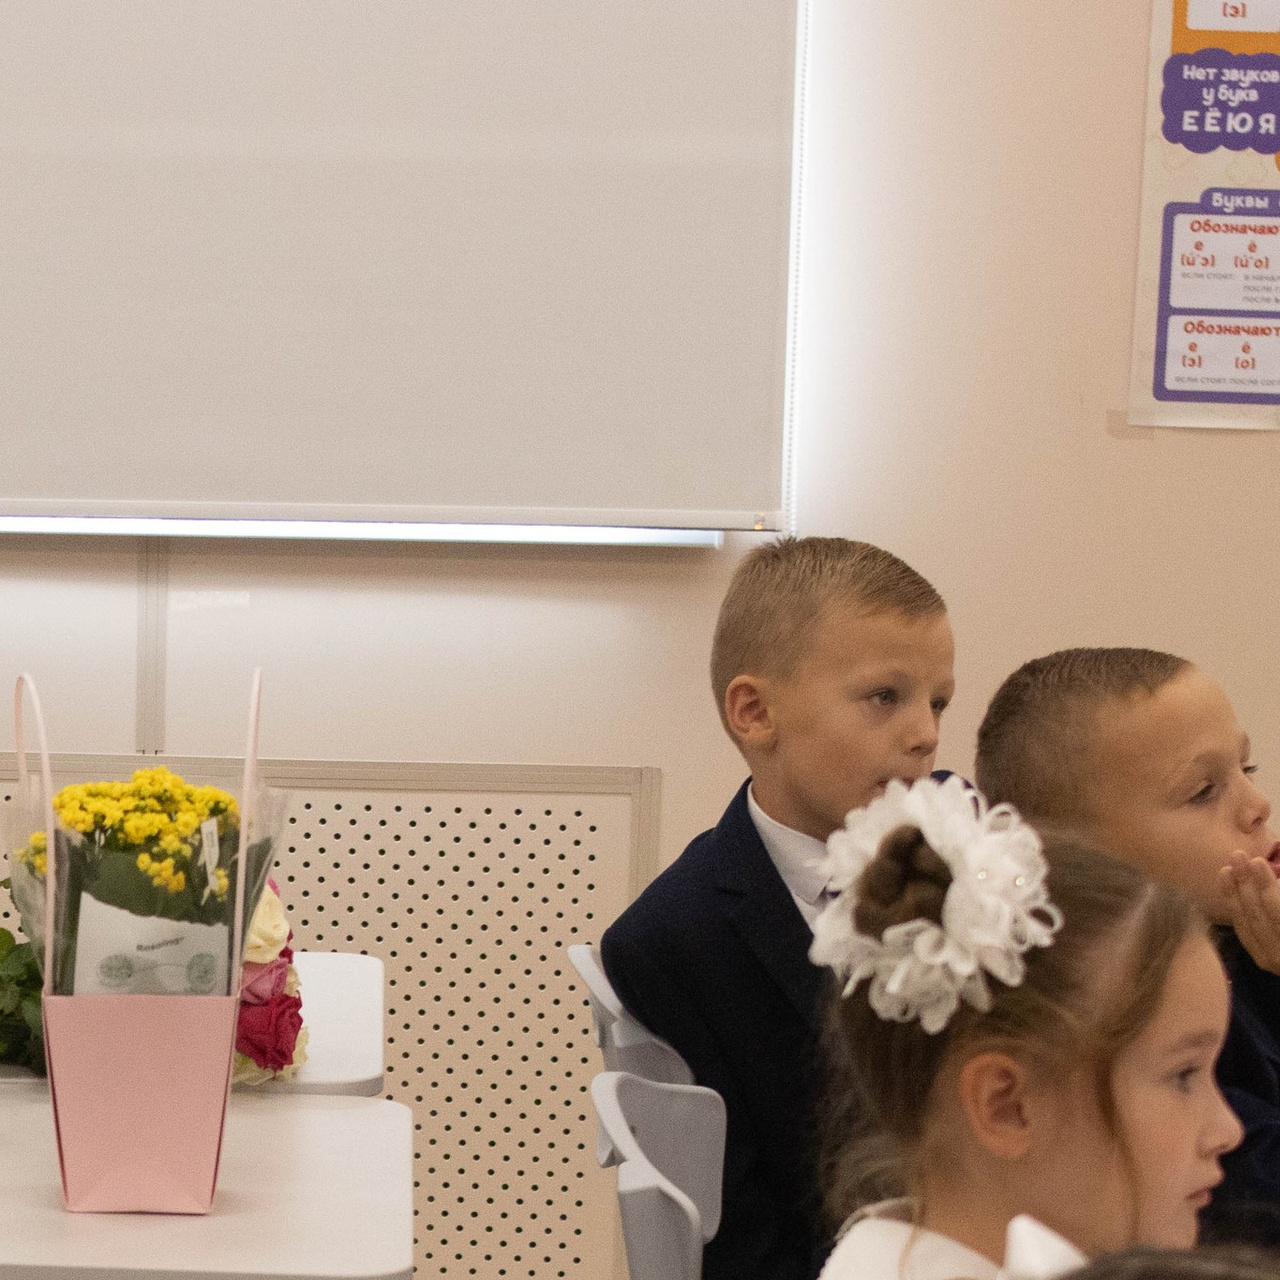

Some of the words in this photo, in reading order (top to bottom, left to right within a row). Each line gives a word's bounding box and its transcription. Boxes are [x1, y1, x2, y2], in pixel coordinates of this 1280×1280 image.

[1182, 64, 1218, 81] Нет
[1221, 68, 1280, 88] звуков
[1202, 87, 1215, 107] у
[1217, 83, 1260, 107] букв
[1182, 110, 1201, 132] Е
[1204, 107, 1222, 133] Ё
[1226, 112, 1254, 134] Ю
[1258, 112, 1276, 135] Я
[1211, 191, 1269, 213] Буквы
[1190, 219, 1280, 235] Обозначаю
